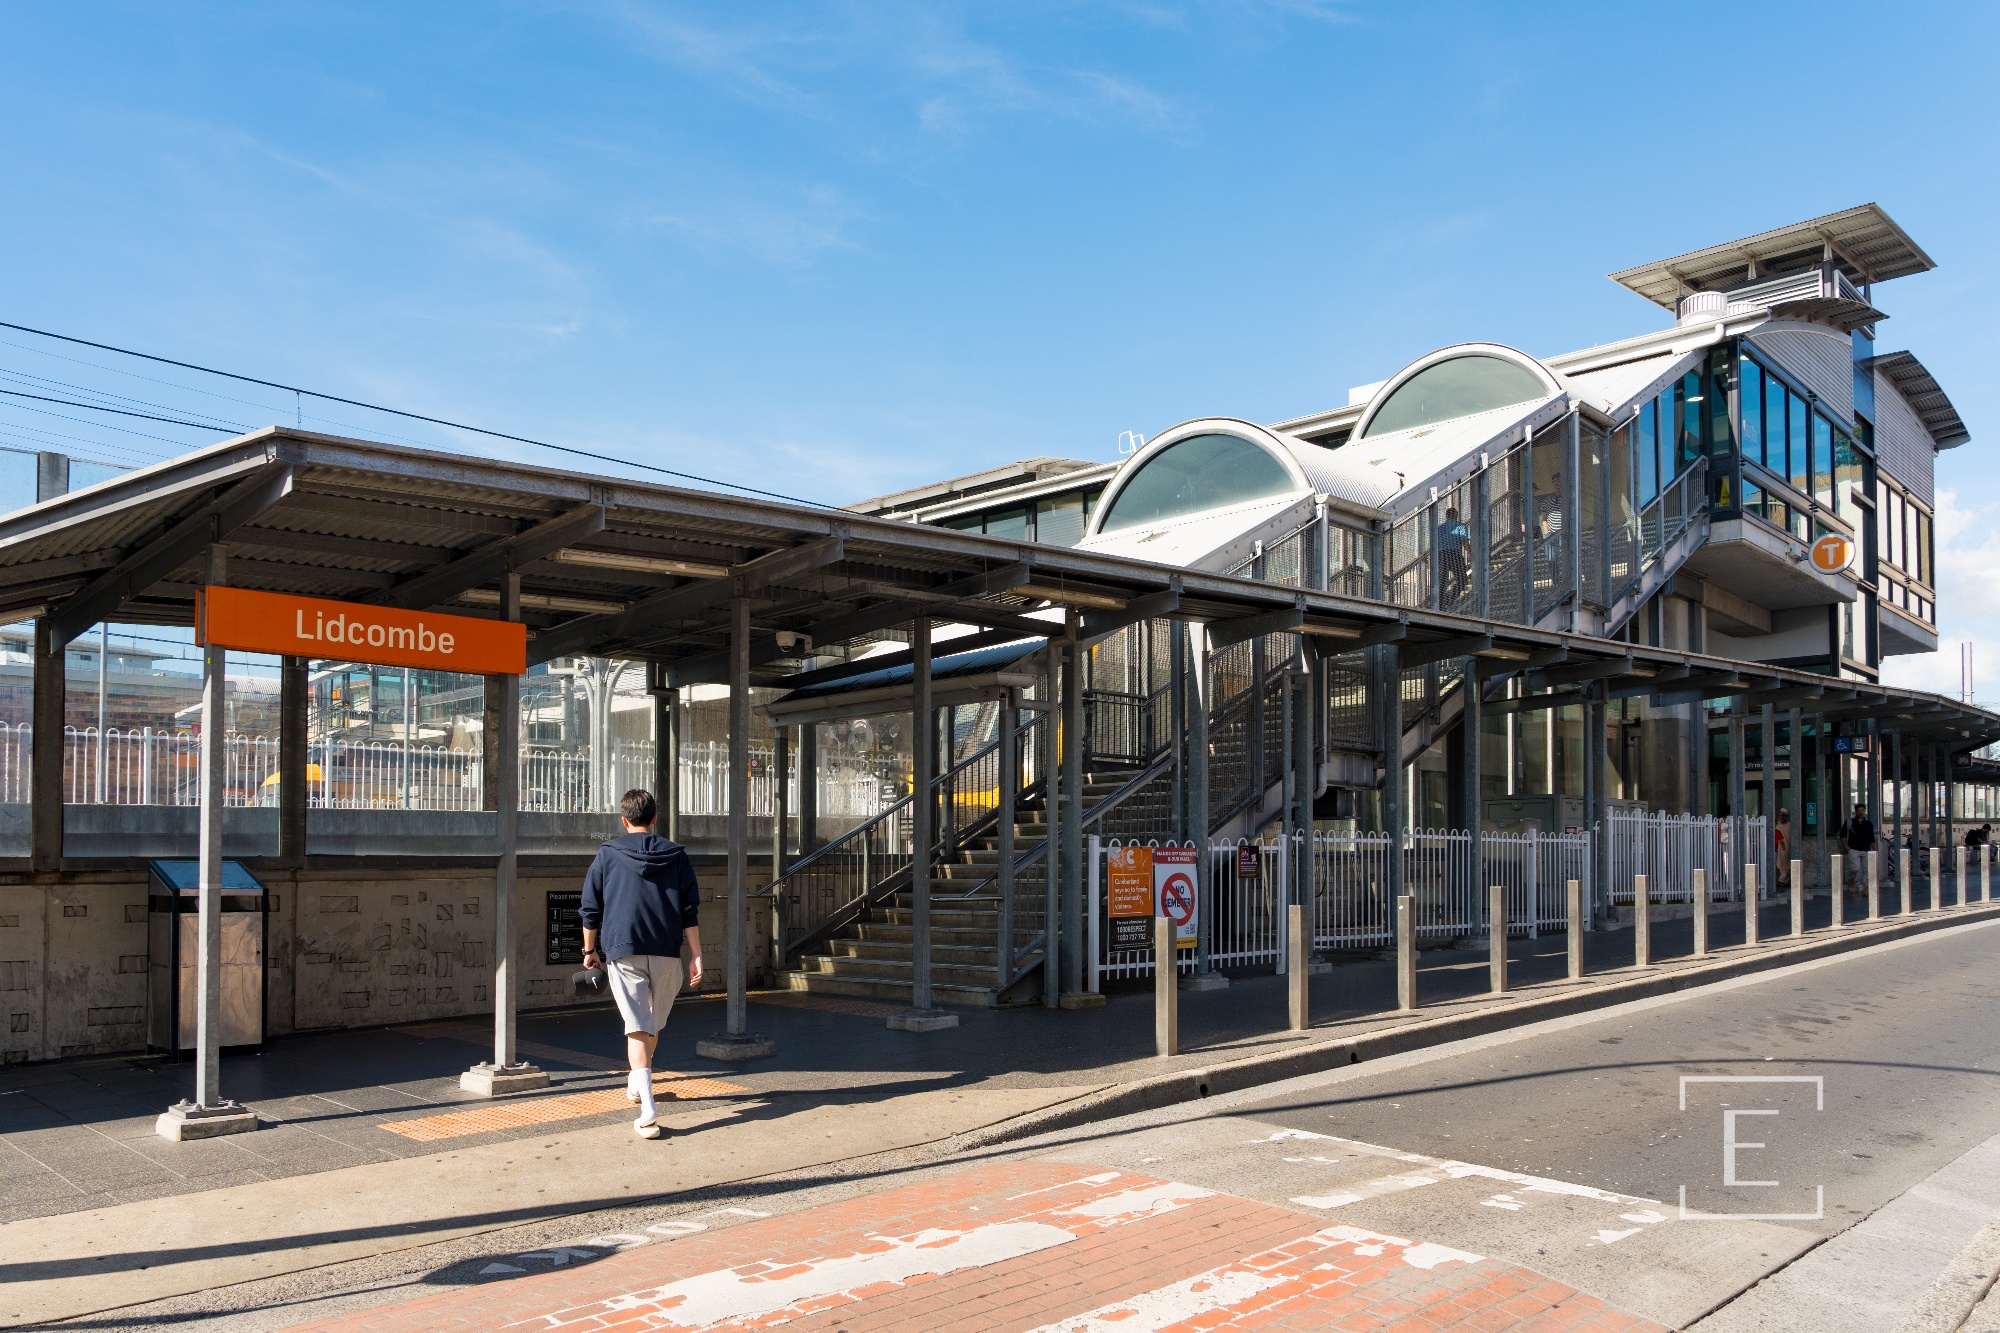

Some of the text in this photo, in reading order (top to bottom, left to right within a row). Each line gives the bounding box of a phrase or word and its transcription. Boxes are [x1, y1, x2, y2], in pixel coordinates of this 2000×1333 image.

[1822, 543, 1839, 565] T
[296, 609, 455, 654] Lidcombe
[1135, 885, 1147, 894] family
[1175, 885, 1185, 895] NO
[1116, 925, 1147, 933] 1800RESPECT
[1117, 933, 1128, 941] 1800
